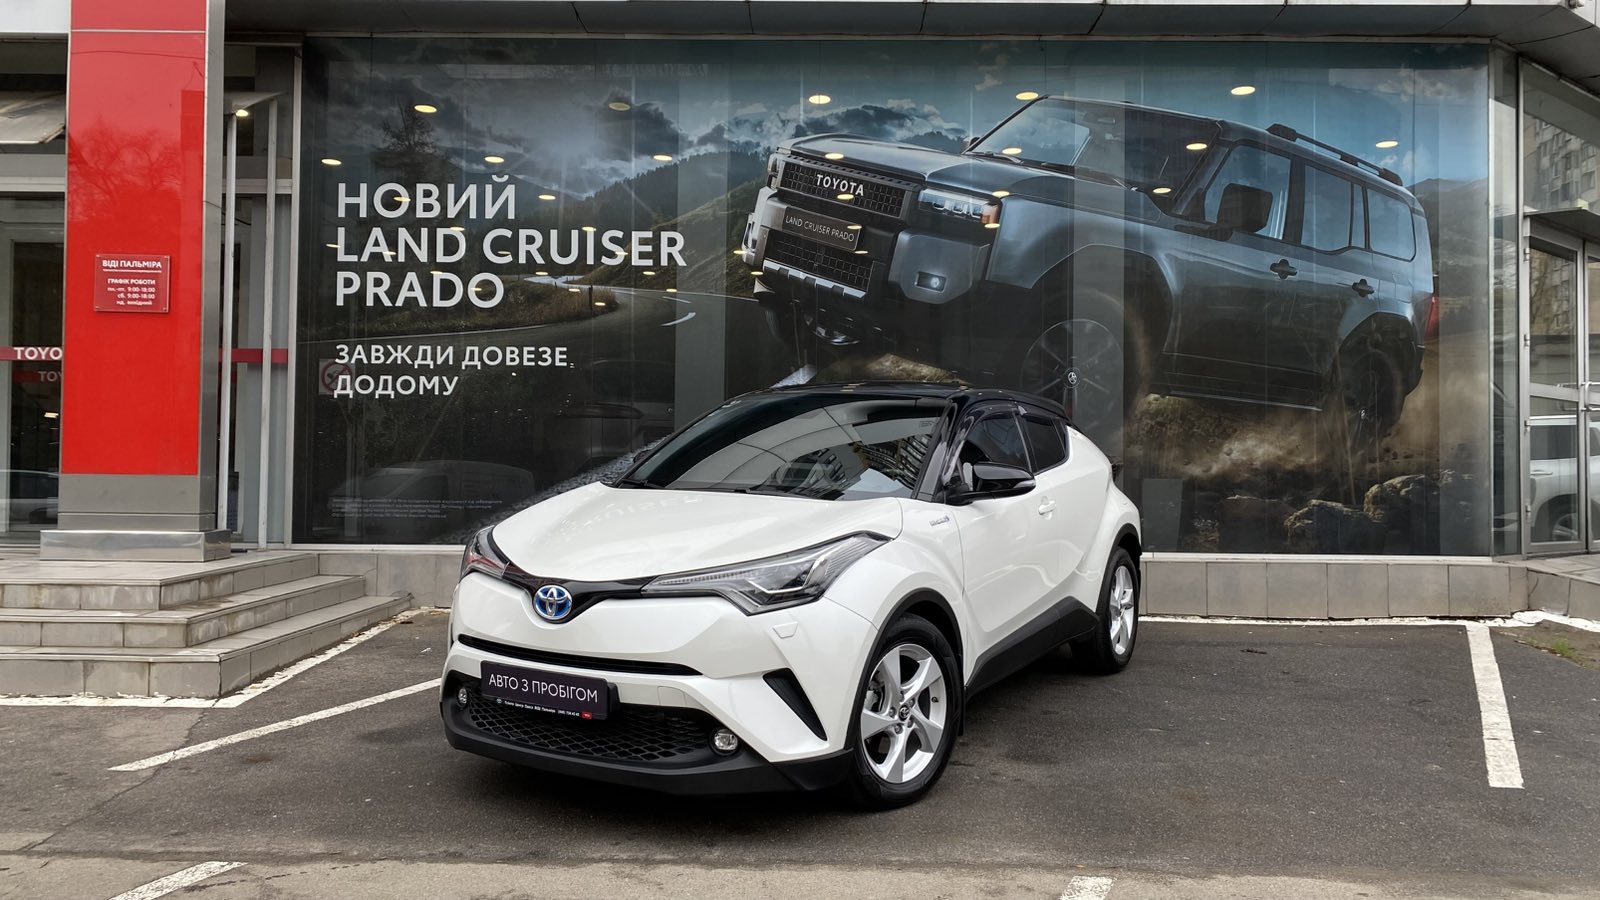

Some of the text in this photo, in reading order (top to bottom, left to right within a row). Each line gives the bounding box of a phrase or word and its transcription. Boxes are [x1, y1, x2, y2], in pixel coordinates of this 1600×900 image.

[337, 174, 516, 219] НОВИЙ
[816, 174, 864, 196] TOYOTA
[785, 215, 855, 242] LAND CRUISER PRADO
[337, 226, 687, 267] LAND CRUISER
[120, 260, 162, 268] ПАЛЬМІРА
[335, 271, 505, 309] PRADO
[335, 344, 568, 370] ЗАВЖДИ ДОВЕЗЕ
[334, 375, 459, 399] ДОДОМУ
[488, 673, 598, 703] АВТО З ПРОБІГОМ
